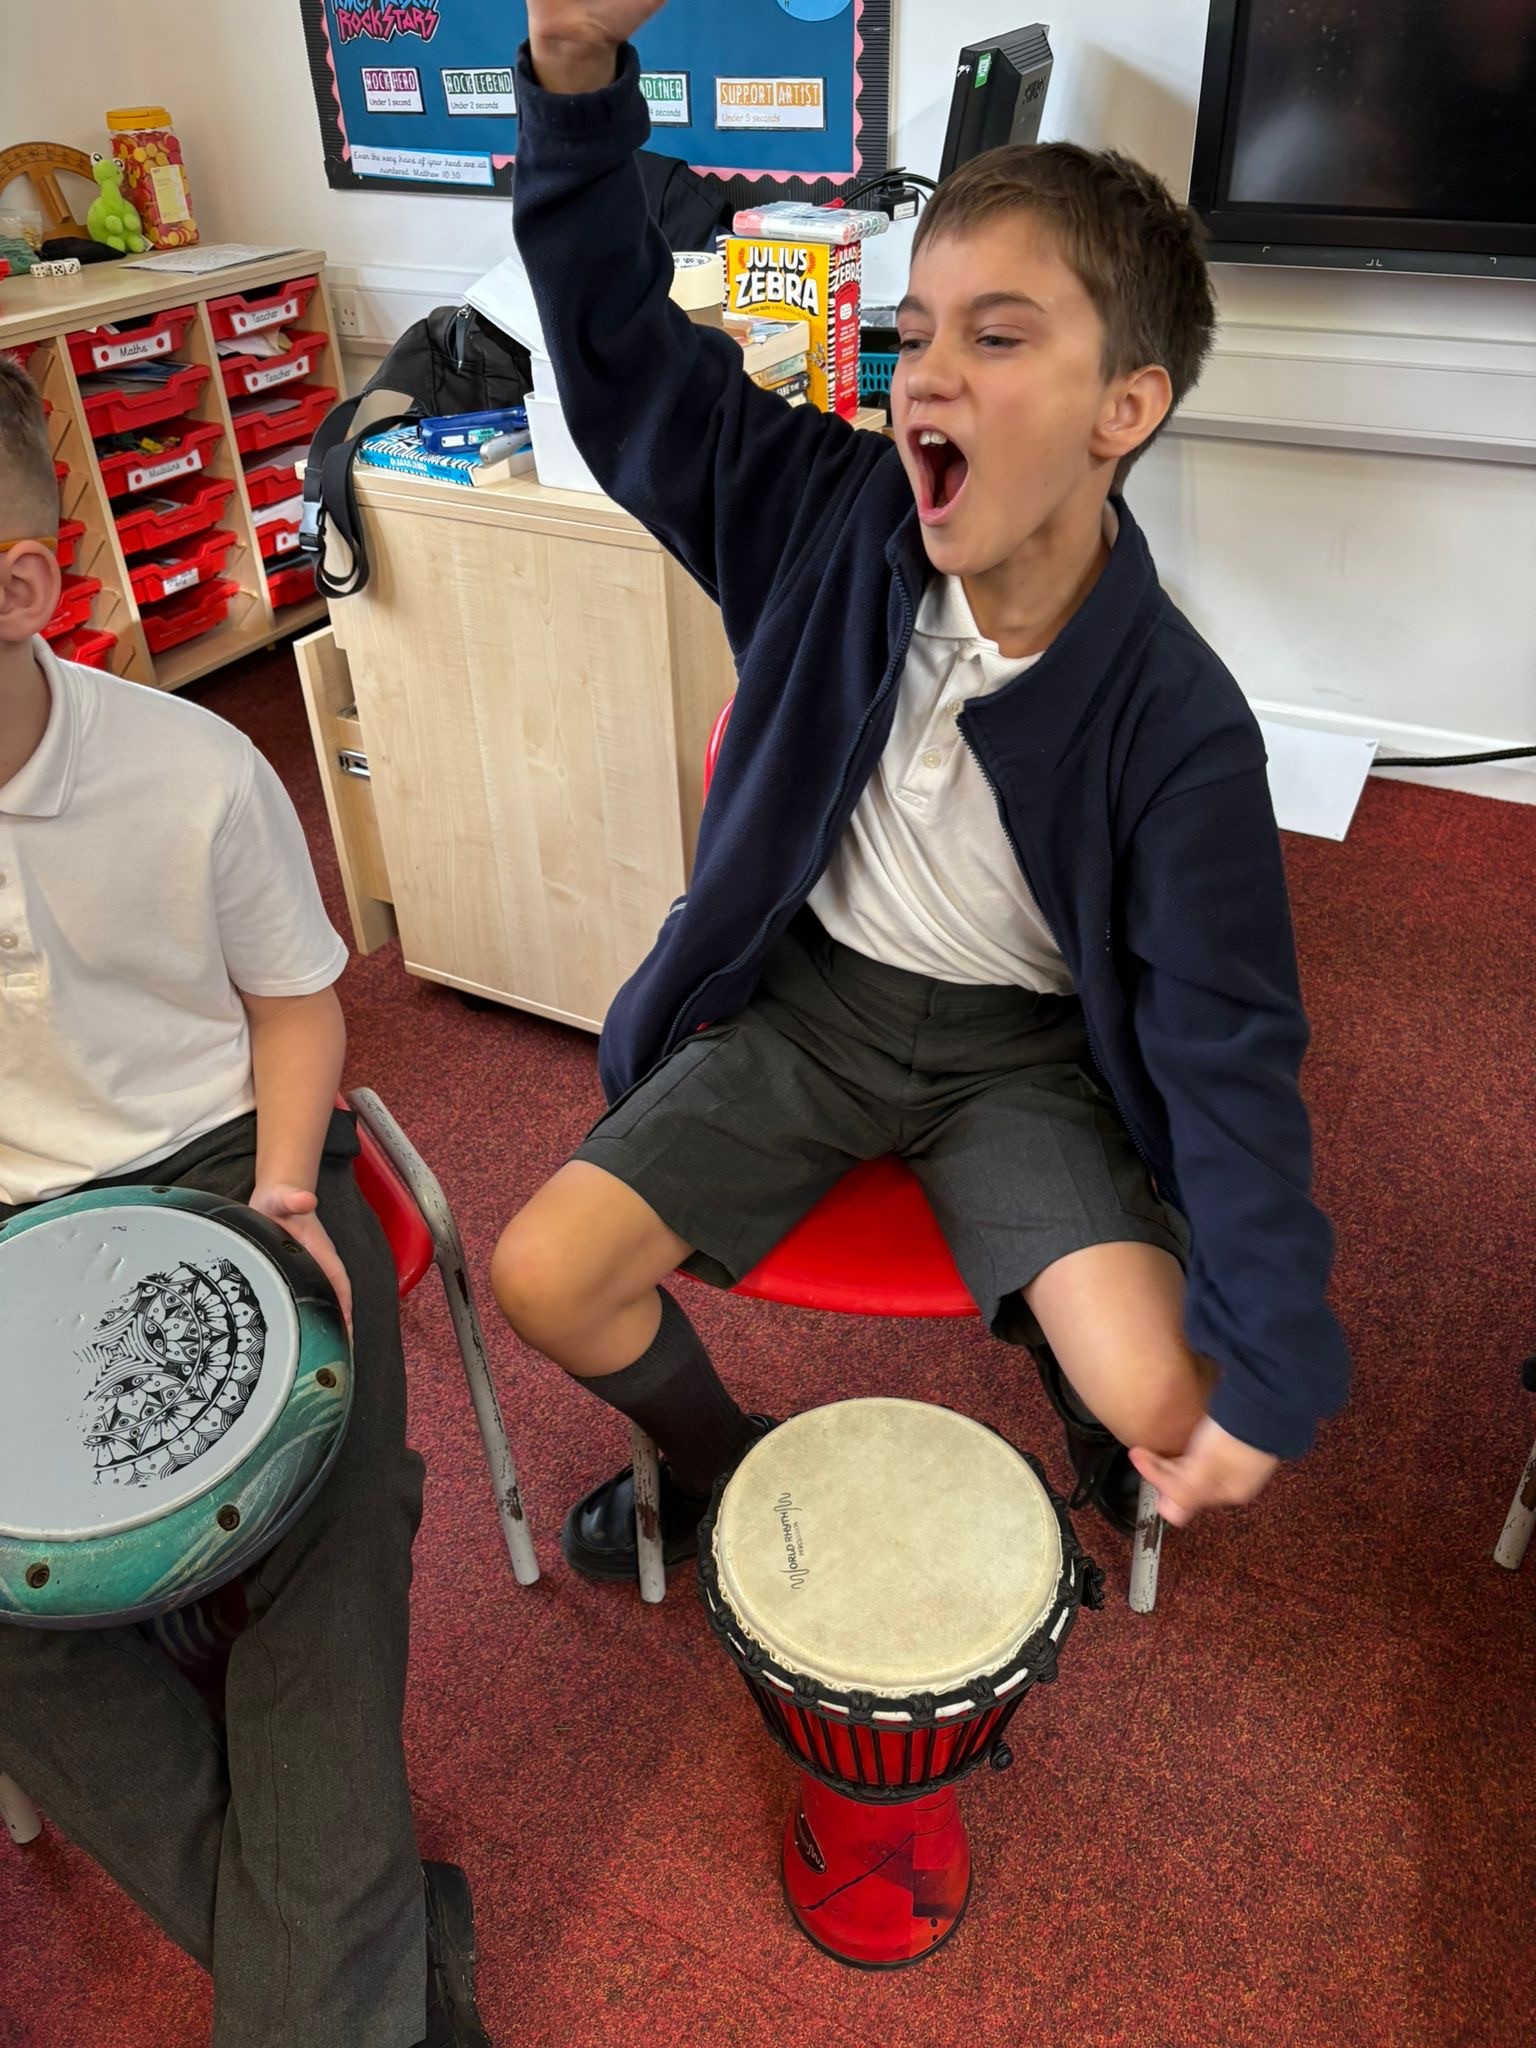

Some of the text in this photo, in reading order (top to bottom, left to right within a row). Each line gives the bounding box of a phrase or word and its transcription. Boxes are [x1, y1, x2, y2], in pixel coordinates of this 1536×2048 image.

[365, 71, 416, 91] ROCK HERO
[446, 73, 511, 93] ROCK LEGEND
[392, 98, 411, 106] second
[721, 84, 820, 106] SUPPORT ARTIST
[450, 101, 468, 109] Under
[475, 101, 499, 110] seconds
[655, 108, 681, 117] seconds
[722, 113, 743, 122] Under
[752, 113, 781, 123] seconds
[746, 246, 808, 271] JULIUS
[735, 270, 820, 316] ZEBRA
[251, 310, 279, 324] Teacher
[120, 343, 148, 357] Maths
[264, 369, 292, 383] Teacher
